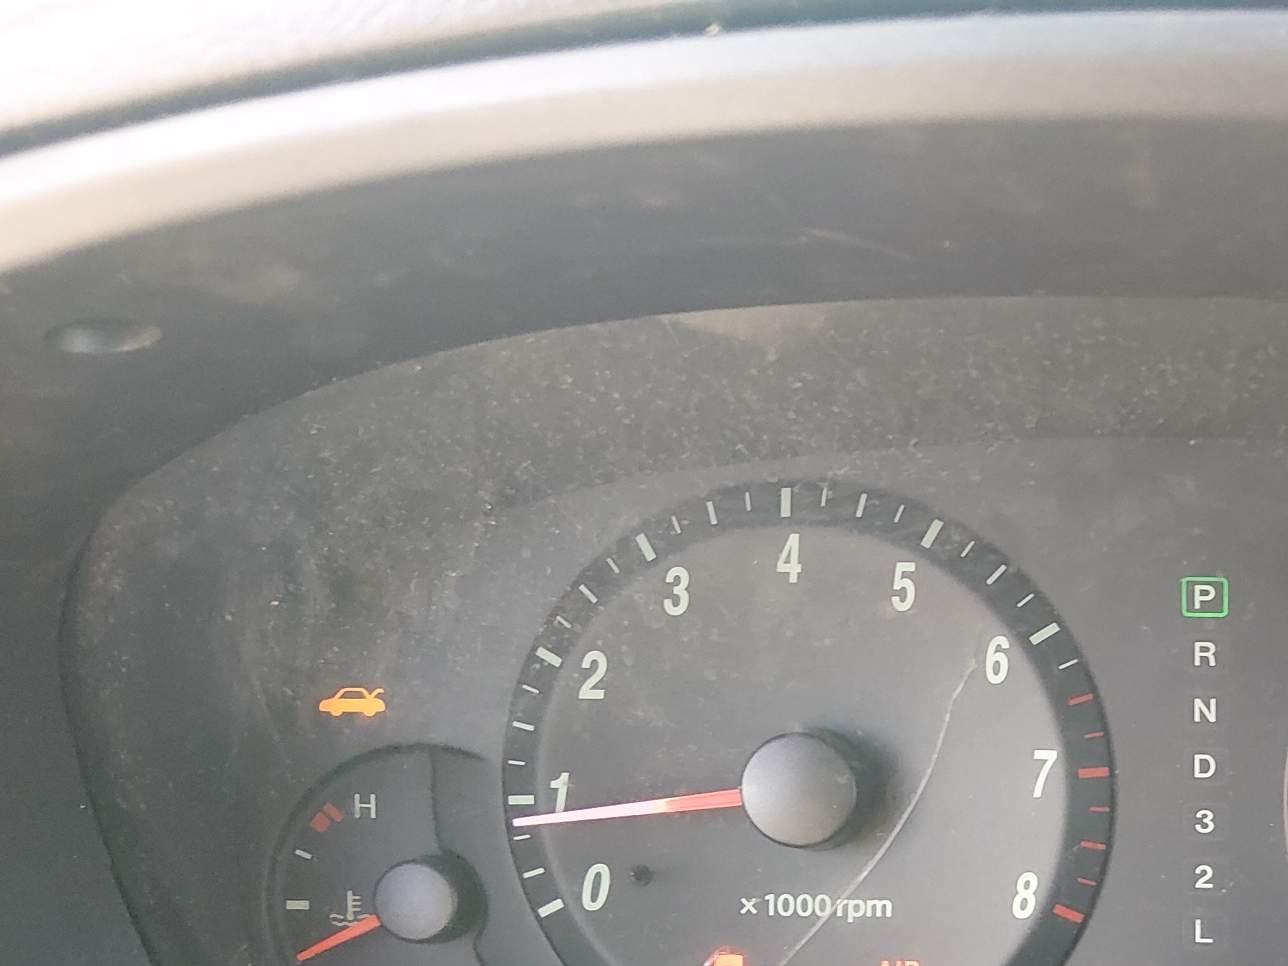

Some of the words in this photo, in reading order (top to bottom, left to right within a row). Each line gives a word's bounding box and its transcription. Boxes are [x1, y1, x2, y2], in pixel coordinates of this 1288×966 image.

[776, 533, 802, 583] 4
[663, 566, 690, 616] 3
[890, 561, 916, 612] 5
[1193, 585, 1216, 609] P
[984, 635, 1010, 685] 6
[1193, 642, 1217, 667] R
[579, 650, 608, 700] 2
[1193, 699, 1217, 723] N
[1032, 750, 1058, 798] 7
[1193, 754, 1217, 779] D
[353, 793, 377, 819] H
[549, 772, 571, 813] 1
[1194, 810, 1215, 834] 3
[581, 863, 611, 912] 0
[1194, 866, 1214, 889] 2
[764, 894, 831, 918] 1000
[834, 897, 893, 923] rpm
[1011, 872, 1038, 920] 8
[1194, 920, 1214, 943] L
